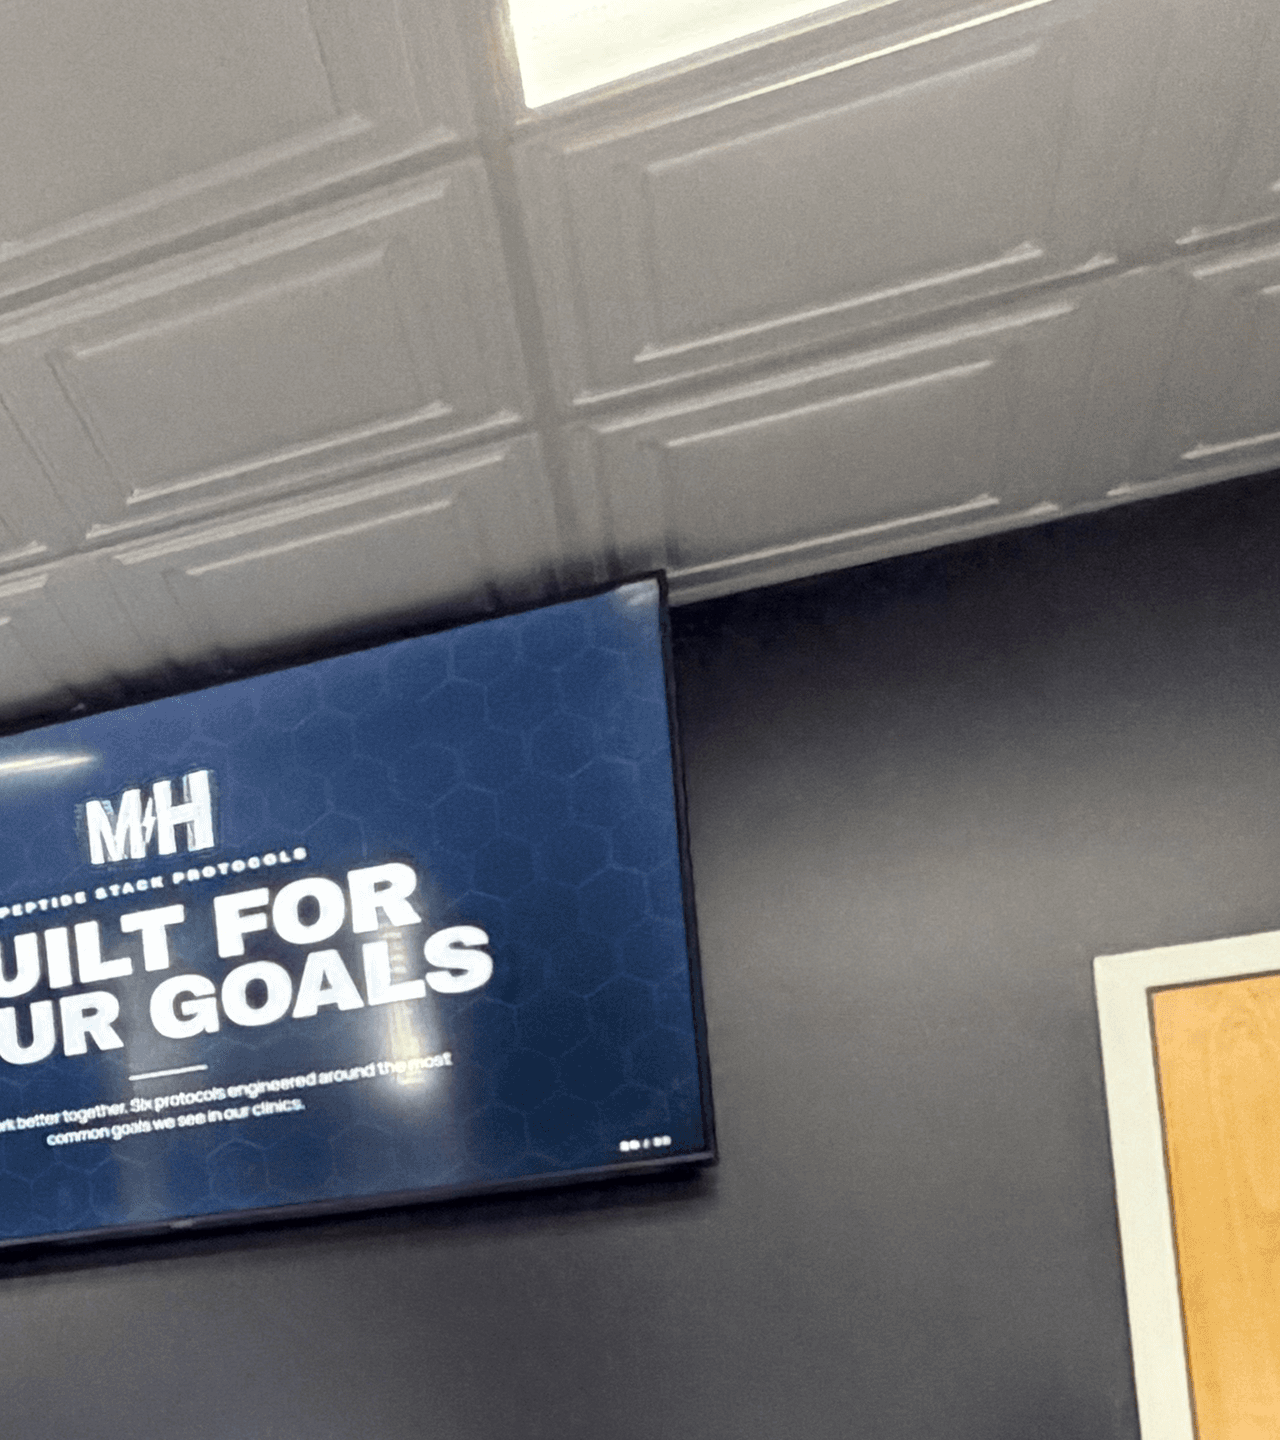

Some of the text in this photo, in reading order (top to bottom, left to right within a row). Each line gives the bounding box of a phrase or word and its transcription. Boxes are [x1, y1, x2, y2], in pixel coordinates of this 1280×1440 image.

[94, 876, 164, 900] STACK
[172, 847, 308, 884] PROTOCOLS
[213, 862, 421, 958] FOR
[149, 925, 493, 1039] GOALS
[16, 1112, 60, 1130] better
[62, 1101, 129, 1125] together.
[130, 1097, 152, 1113] Six
[153, 1086, 227, 1113] protocols
[227, 1070, 316, 1099] engineered
[318, 1061, 376, 1084] around
[376, 1058, 407, 1076] the
[407, 1051, 454, 1072] most
[46, 1097, 306, 1147] common goals we see in our clinics.
